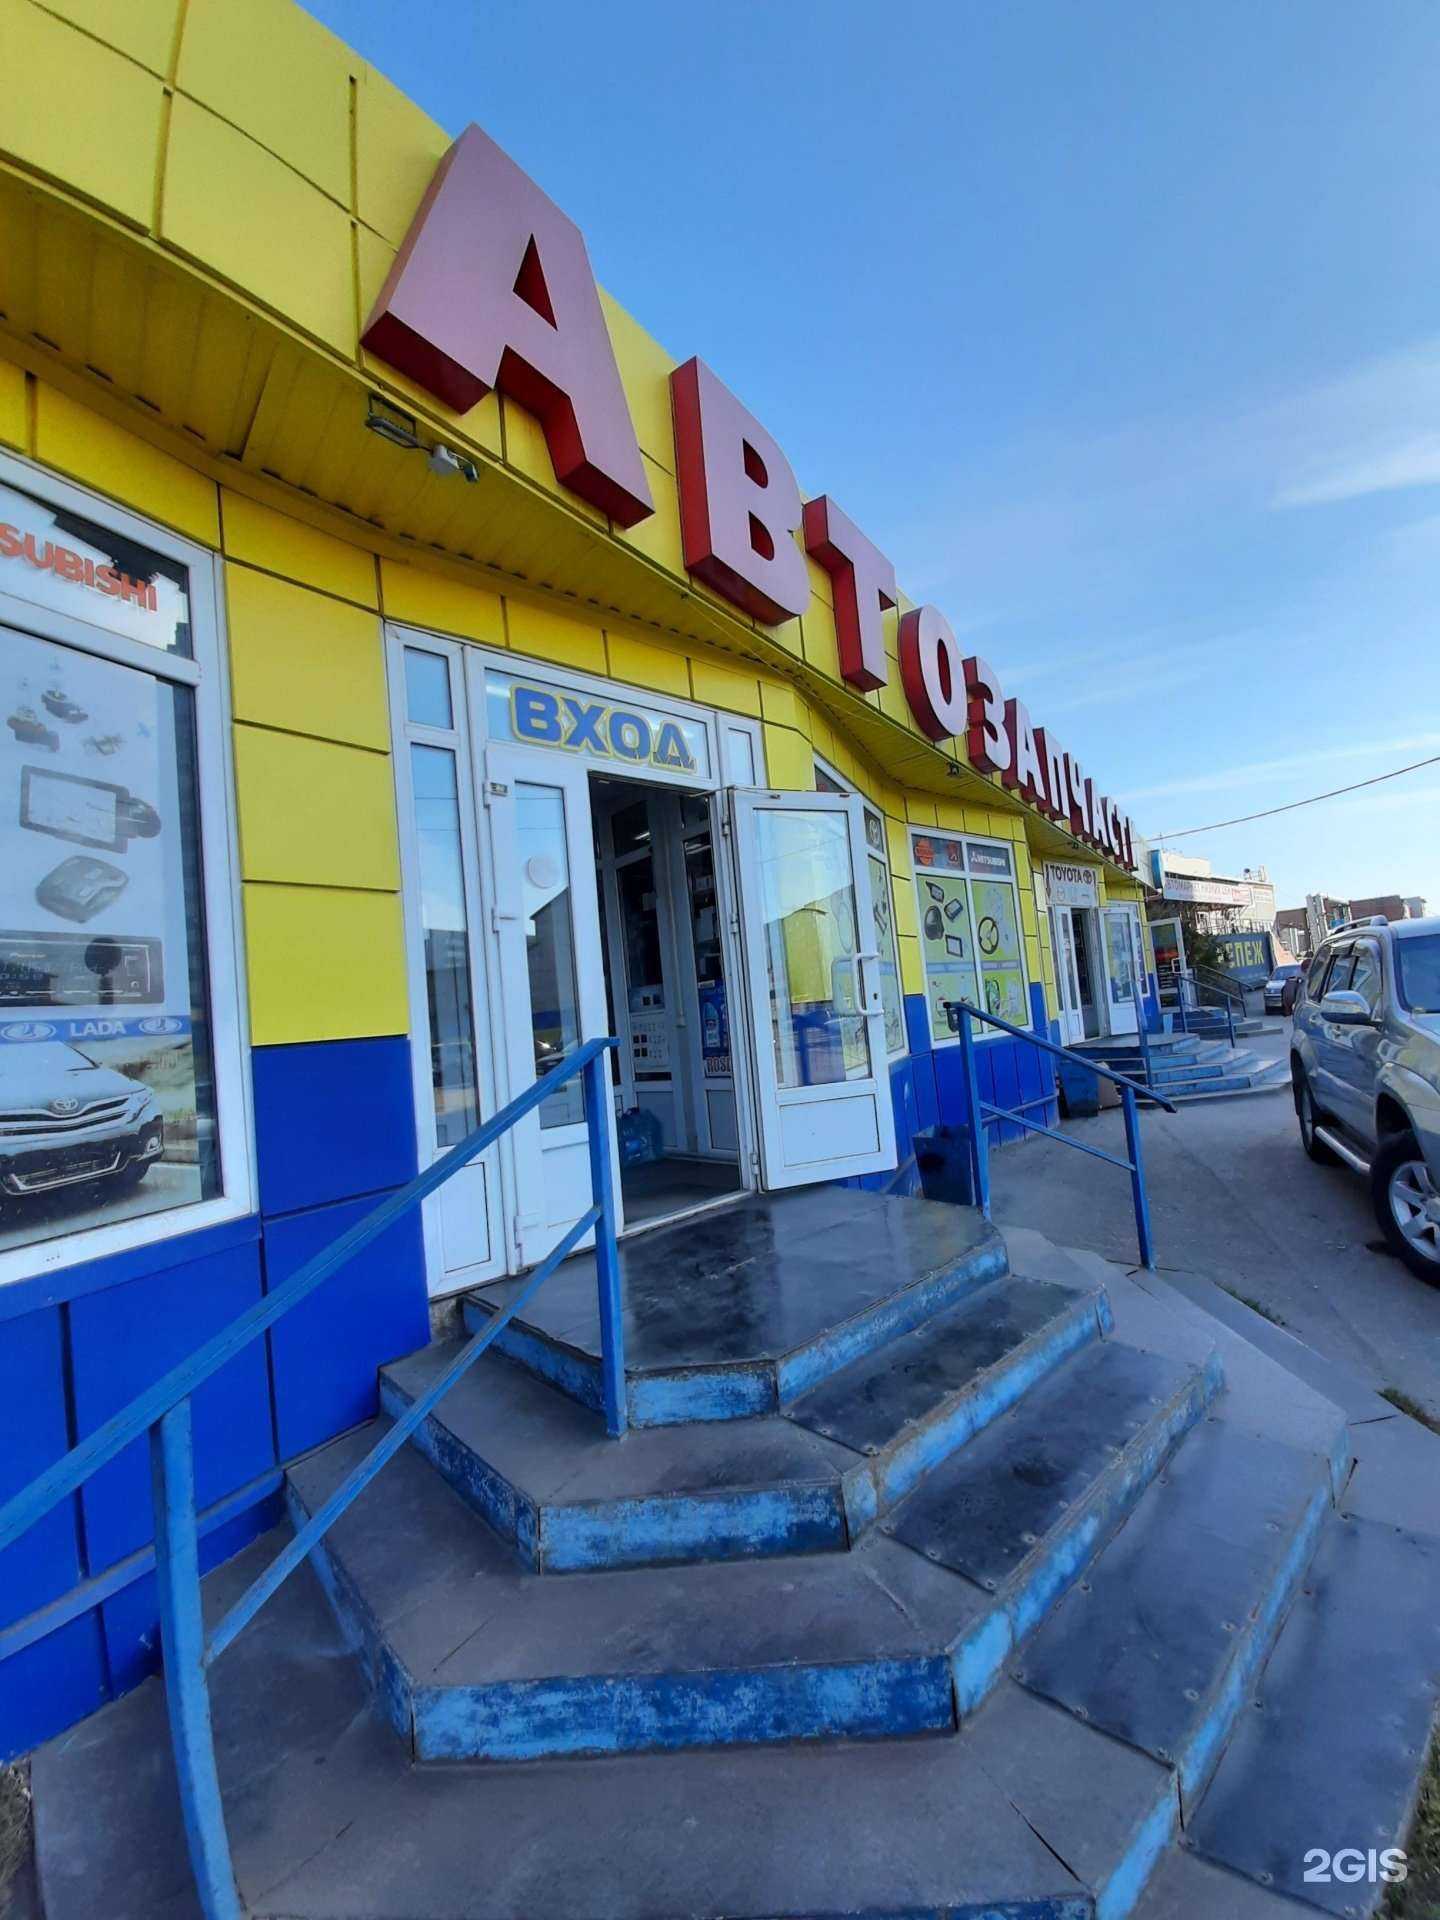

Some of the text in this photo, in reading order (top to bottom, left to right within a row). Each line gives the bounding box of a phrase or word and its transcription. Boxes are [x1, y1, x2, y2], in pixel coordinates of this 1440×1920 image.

[511, 685, 696, 772] ВХОД
[1050, 865, 1082, 884] TOYOTA
[70, 1020, 126, 1037] LADA
